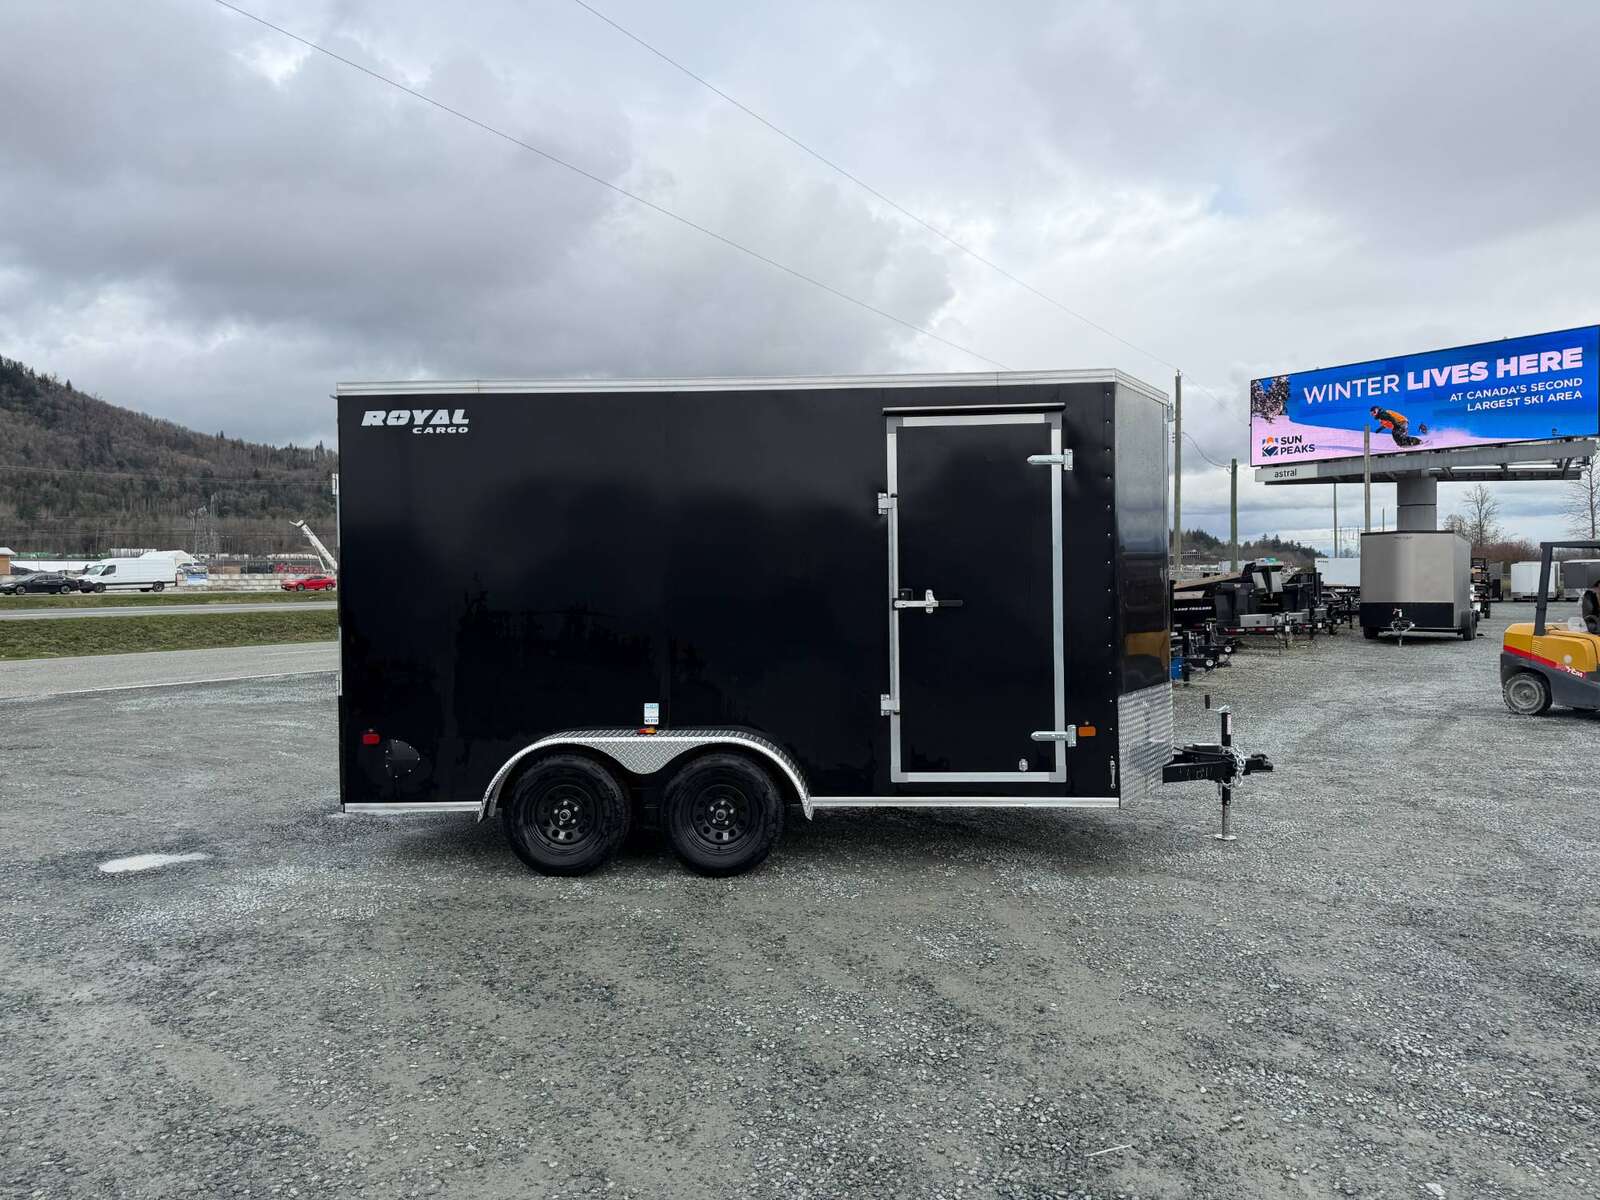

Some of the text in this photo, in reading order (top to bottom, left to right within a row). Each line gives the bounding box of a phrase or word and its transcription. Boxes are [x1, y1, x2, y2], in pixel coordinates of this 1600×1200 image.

[1303, 347, 1583, 405] WINTER LIVES HERE
[1450, 377, 1583, 402] AT CANADA'S SECOND
[1467, 390, 1583, 412] LARGEST SKI AREA
[361, 409, 470, 426] ROYAL
[412, 426, 469, 434] CARGO
[1280, 435, 1303, 446] SUN
[1280, 444, 1316, 456] PEAKS
[1274, 469, 1297, 478] astral
